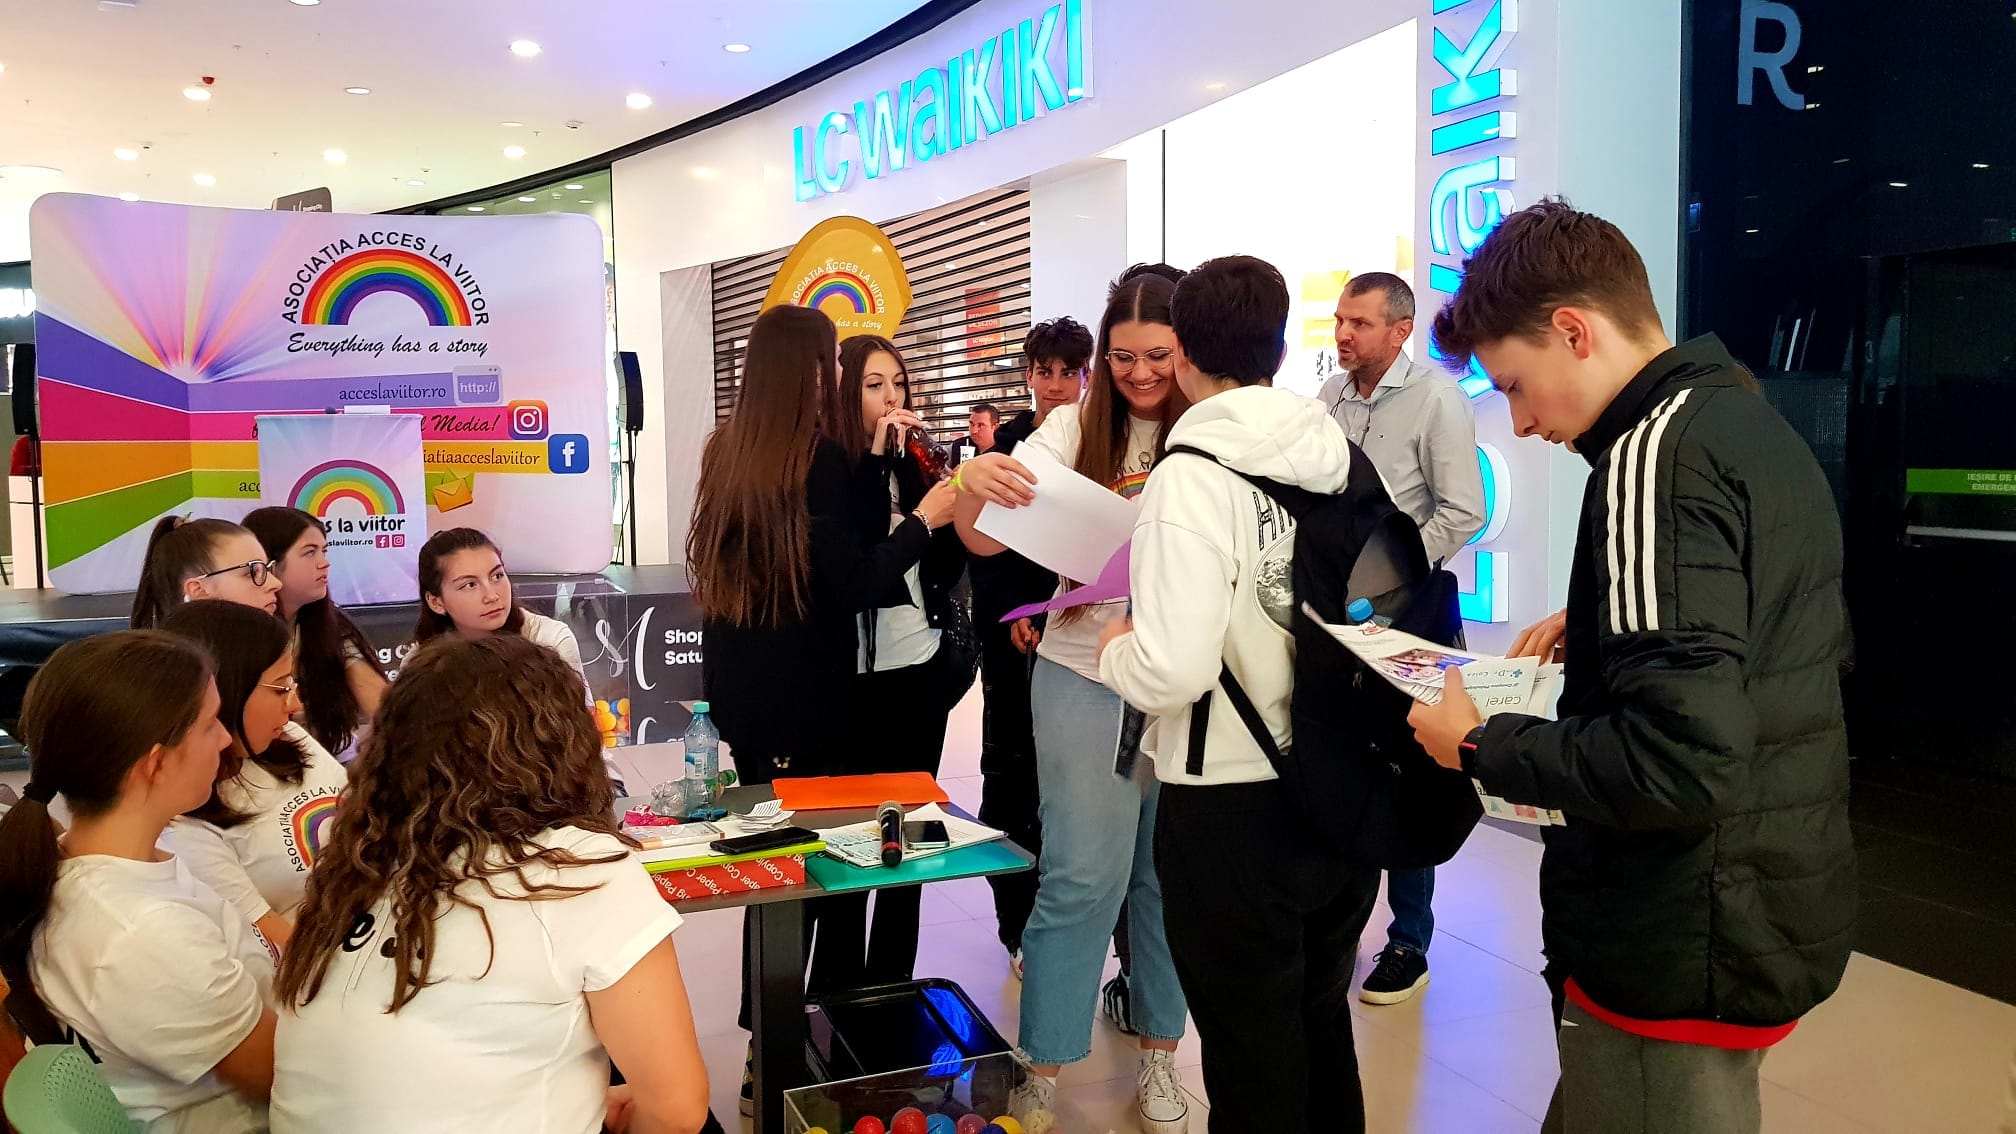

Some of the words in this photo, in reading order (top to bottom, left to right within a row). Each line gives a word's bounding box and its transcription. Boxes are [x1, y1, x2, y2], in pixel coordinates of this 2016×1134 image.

[1737, 0, 1806, 110] R
[793, 112, 849, 202] LC
[357, 231, 427, 251] ACCES
[429, 244, 453, 268] LA
[454, 263, 490, 326] VIITOR
[825, 261, 859, 273] ACCES
[858, 269, 871, 282] LA
[869, 280, 885, 314] VIITOR
[287, 332, 385, 358] Everything
[391, 334, 422, 353] has
[428, 341, 440, 353] a
[447, 338, 489, 358] story
[338, 383, 447, 401] acceslaviitor.ro
[459, 382, 497, 395] http://
[431, 415, 502, 433] Media!
[338, 518, 354, 533] la
[359, 515, 406, 532] viitor
[309, 787, 327, 798] LA
